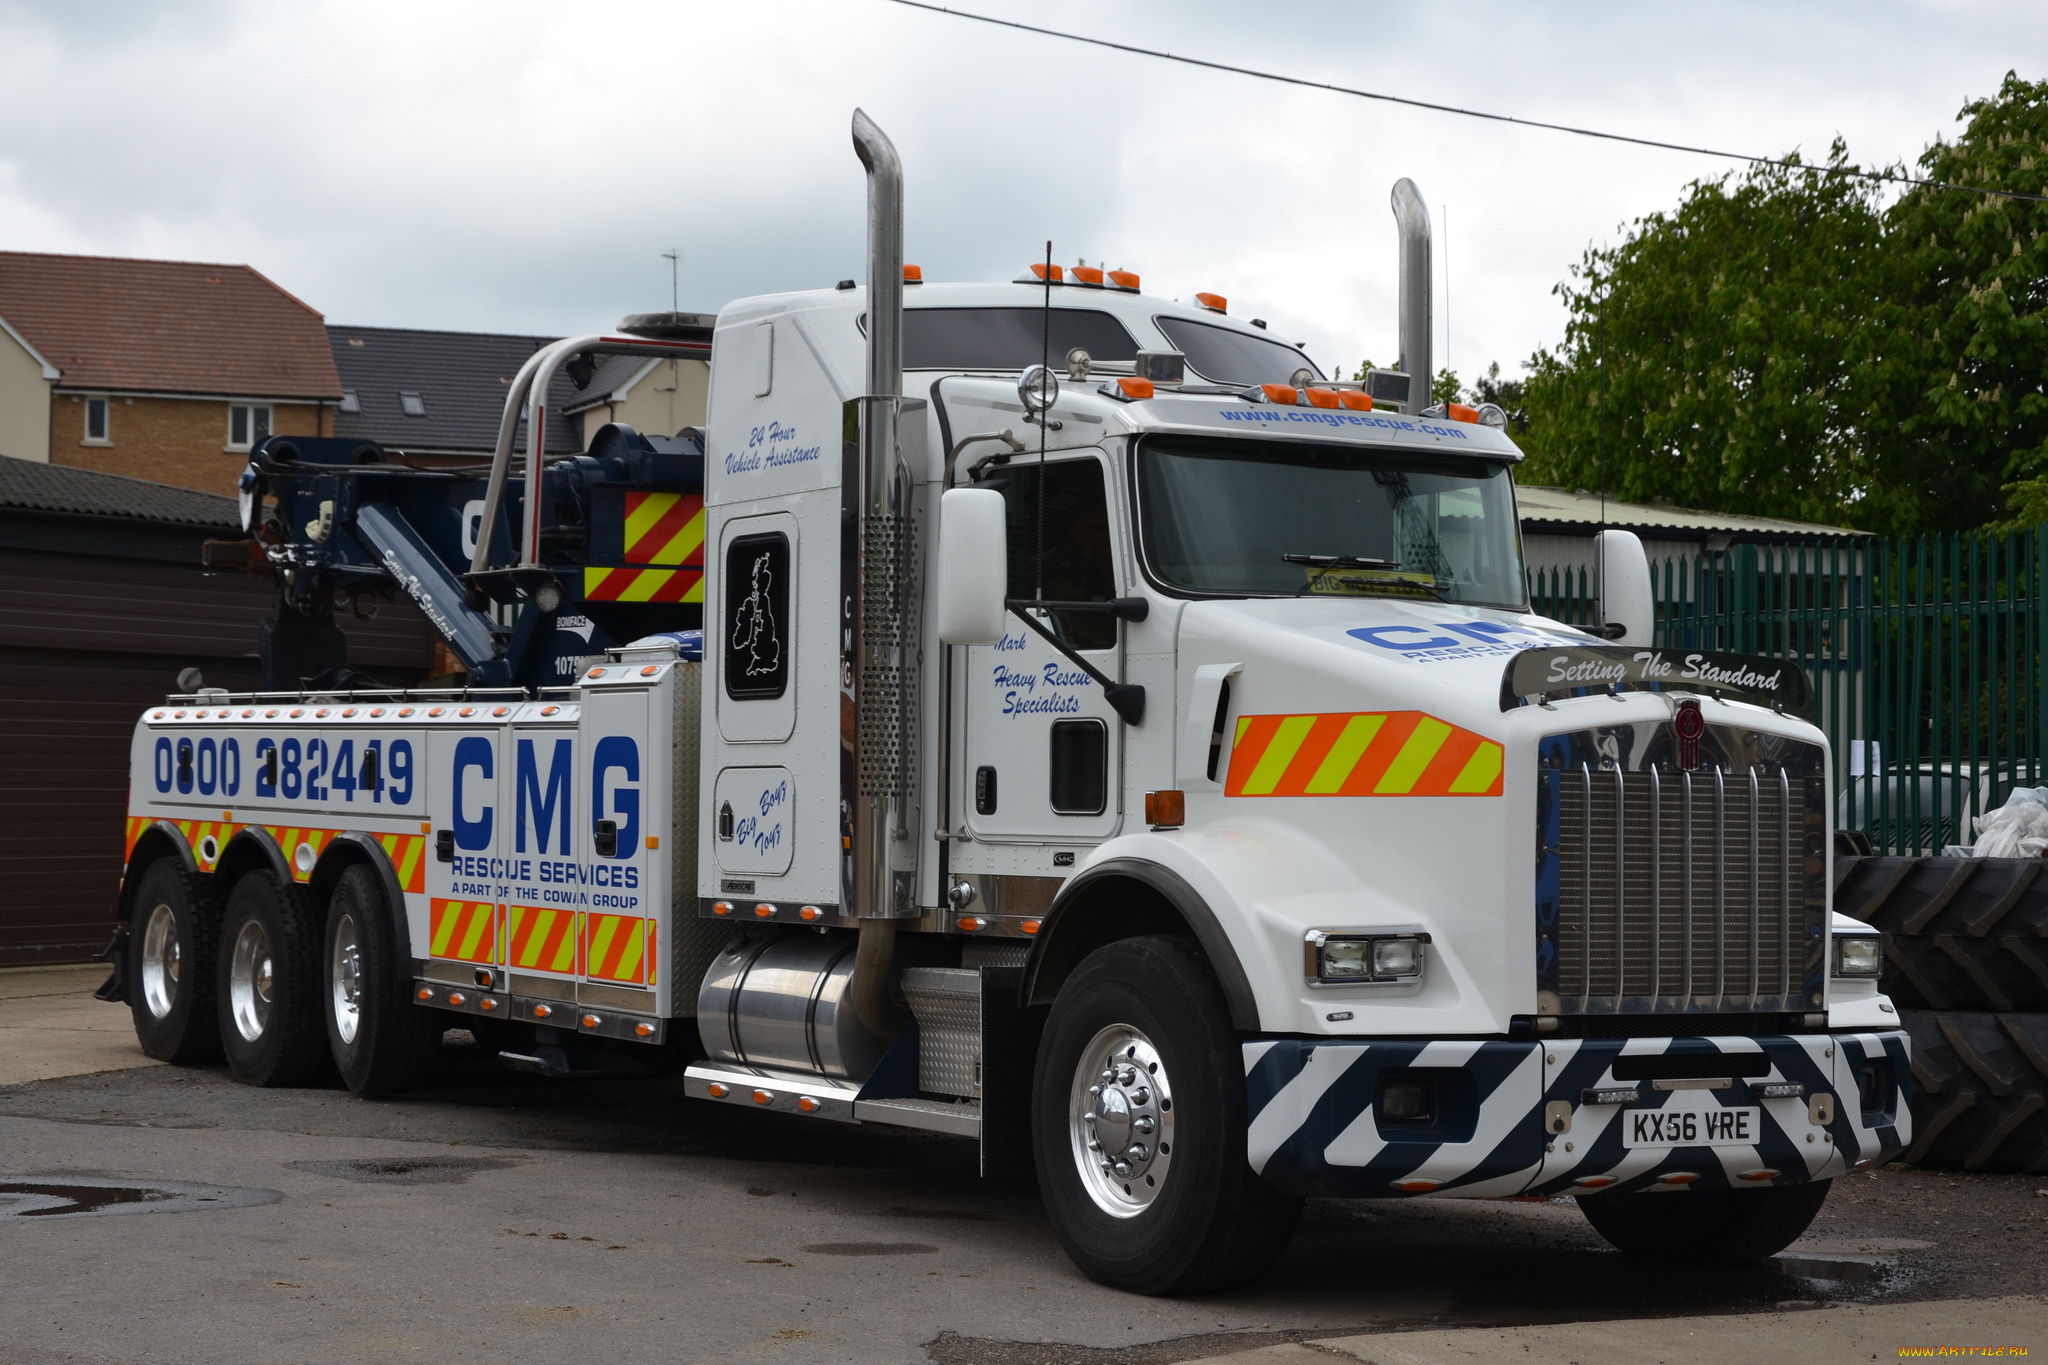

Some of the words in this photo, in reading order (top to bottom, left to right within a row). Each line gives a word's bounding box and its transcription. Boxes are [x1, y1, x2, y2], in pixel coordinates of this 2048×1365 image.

[749, 426, 765, 448] 24
[768, 421, 796, 444] Hour
[1219, 409, 1467, 440] www.cmgrescue.com
[725, 450, 761, 475] Vehicle
[763, 445, 820, 470] Assistance
[382, 549, 408, 590] Setting
[407, 575, 421, 601] The
[419, 594, 458, 641] Standard
[556, 615, 586, 628] BONIFACE
[993, 665, 1037, 694] Heavy
[1042, 662, 1093, 687] Rescue
[1547, 656, 1628, 683] Setting
[1633, 652, 1672, 679] The
[1681, 654, 1782, 691] Standard
[1002, 691, 1080, 720] Specialists
[155, 737, 240, 797] 0800
[256, 737, 413, 805] 282449
[736, 817, 757, 845] Big
[452, 855, 532, 881] RESCUE
[539, 861, 639, 889] SERVICES
[452, 882, 460, 894] A
[462, 883, 491, 897] PART
[494, 885, 510, 898] OF
[515, 886, 539, 900] THE
[592, 893, 638, 909] GROUP
[1633, 1113, 1697, 1142] KX56
[1704, 1111, 1750, 1140] VRE
